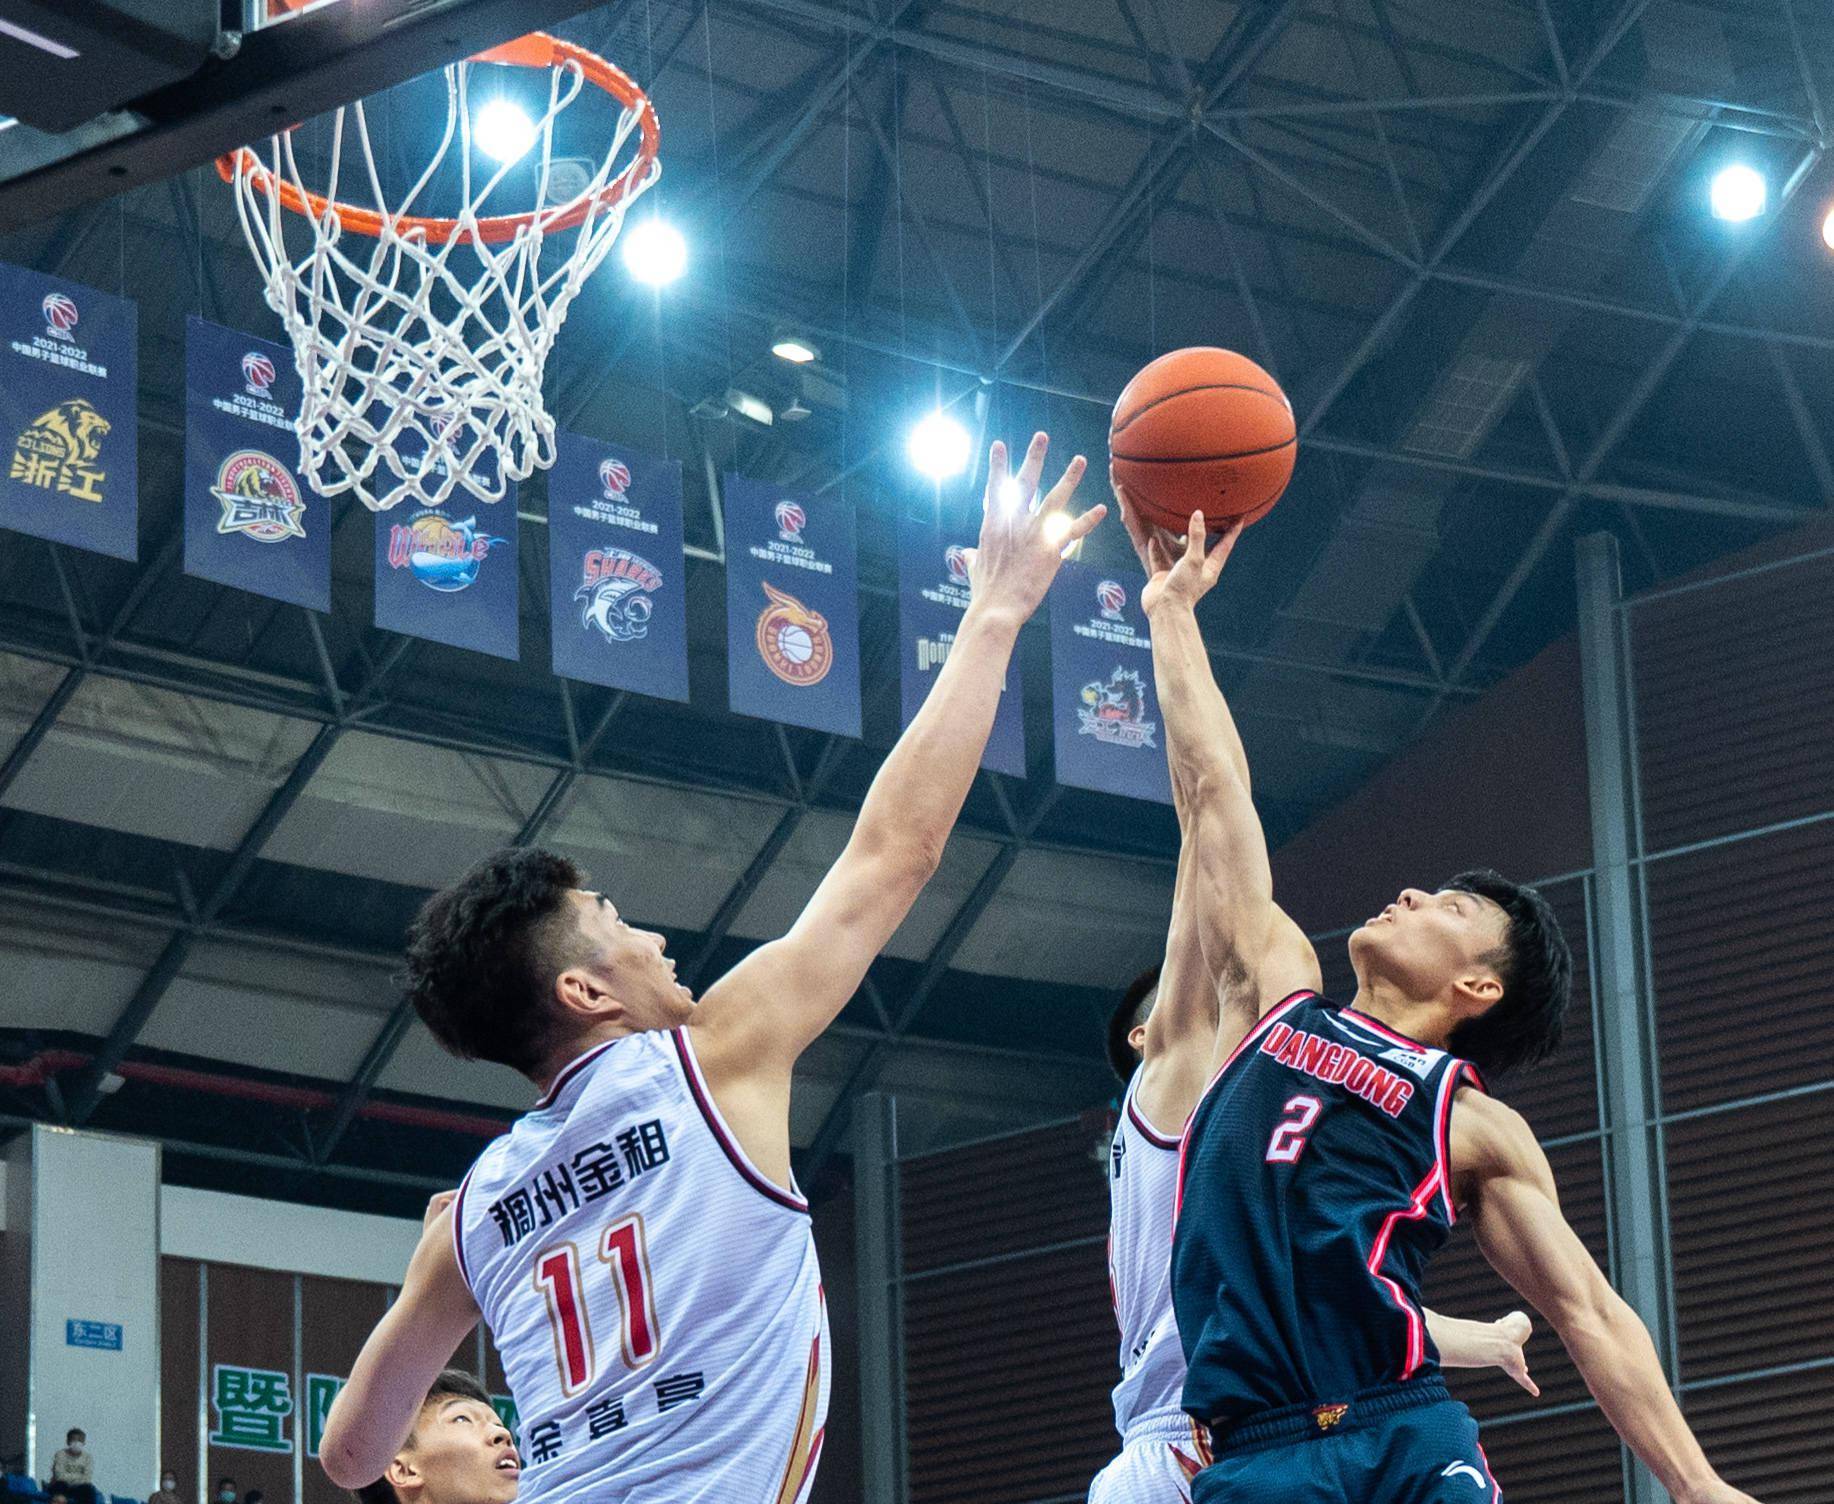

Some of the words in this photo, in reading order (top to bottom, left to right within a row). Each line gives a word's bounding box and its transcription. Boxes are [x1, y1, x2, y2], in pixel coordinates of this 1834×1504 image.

[33, 337, 88, 361] 2021-2022
[212, 398, 297, 432] 中国男子篮球职业联
[233, 394, 285, 418] 2021-2022
[10, 451, 106, 503] 浙江
[592, 500, 640, 519] 2021-2022
[768, 541, 816, 559] 2021-2022
[939, 584, 972, 600] 2021-20
[1090, 619, 1135, 636] 2021-2022
[1264, 1093, 1323, 1164] 2
[488, 1118, 671, 1248] 稠州金租
[533, 1211, 661, 1399] 11
